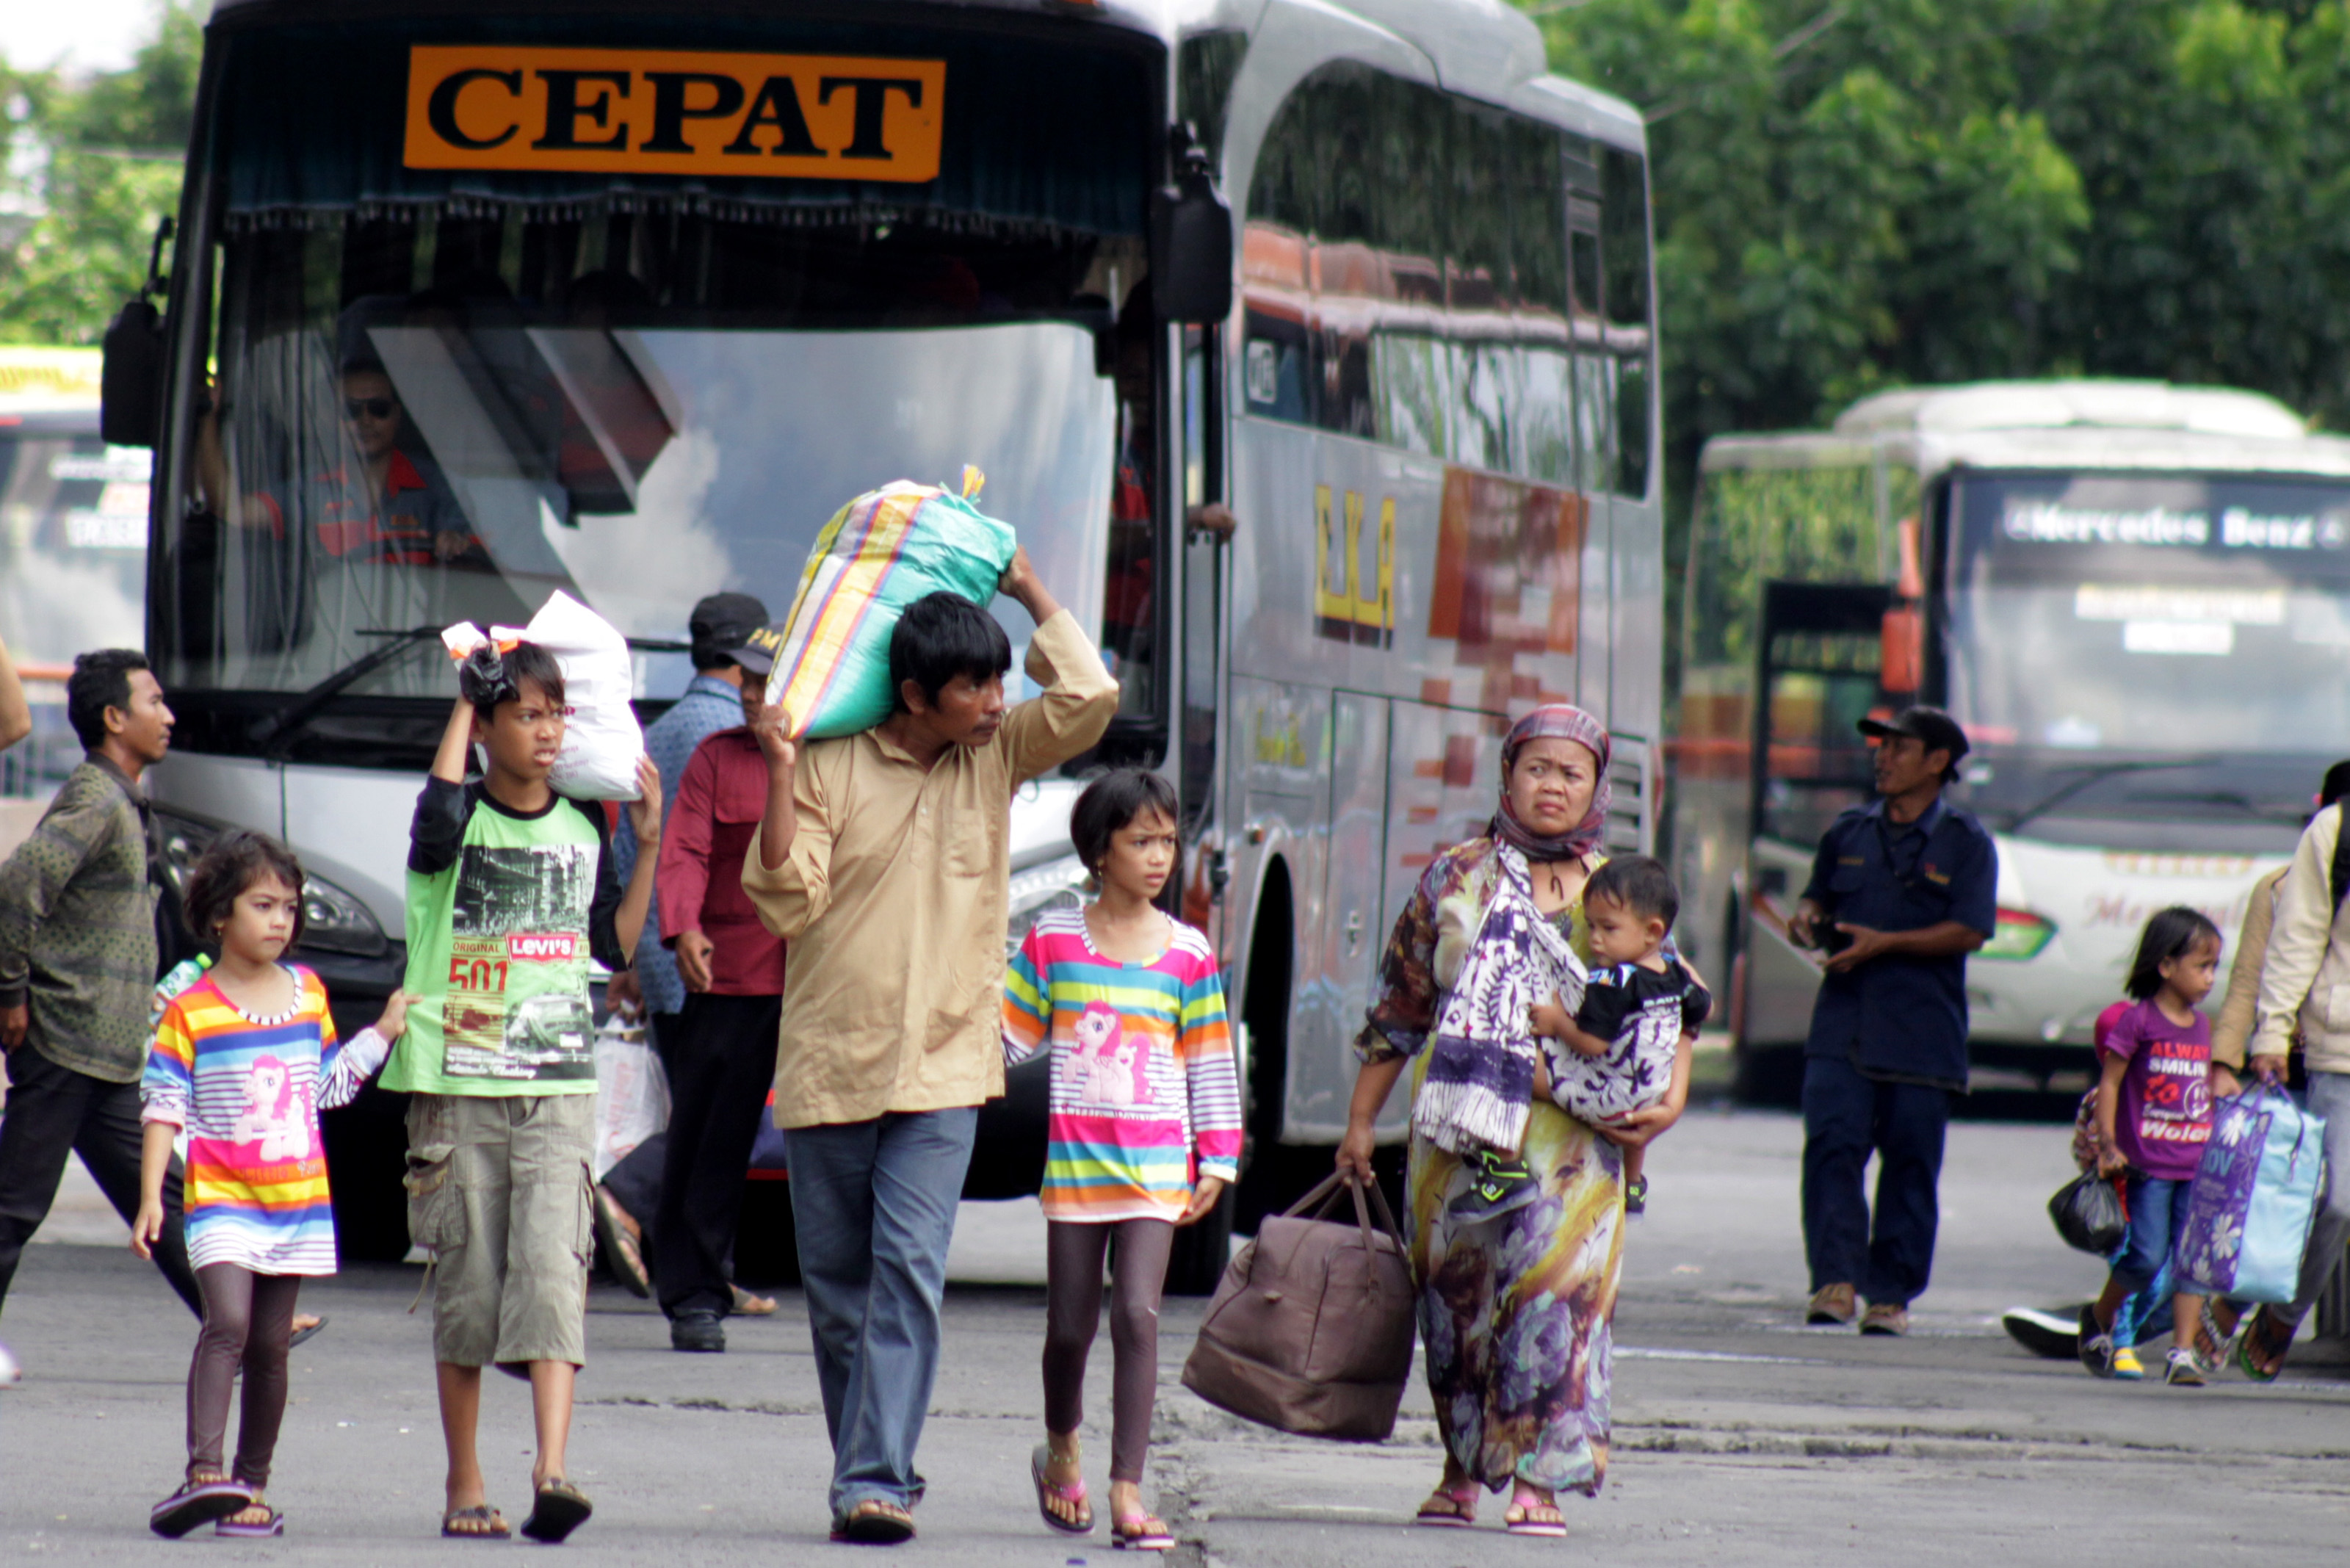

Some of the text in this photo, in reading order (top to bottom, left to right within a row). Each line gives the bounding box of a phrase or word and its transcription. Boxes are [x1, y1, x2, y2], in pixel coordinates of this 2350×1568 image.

[427, 68, 923, 161] CEPAT
[2222, 506, 2314, 549] Benz
[453, 942, 499, 953] ORIGINAL
[449, 958, 508, 991] 501
